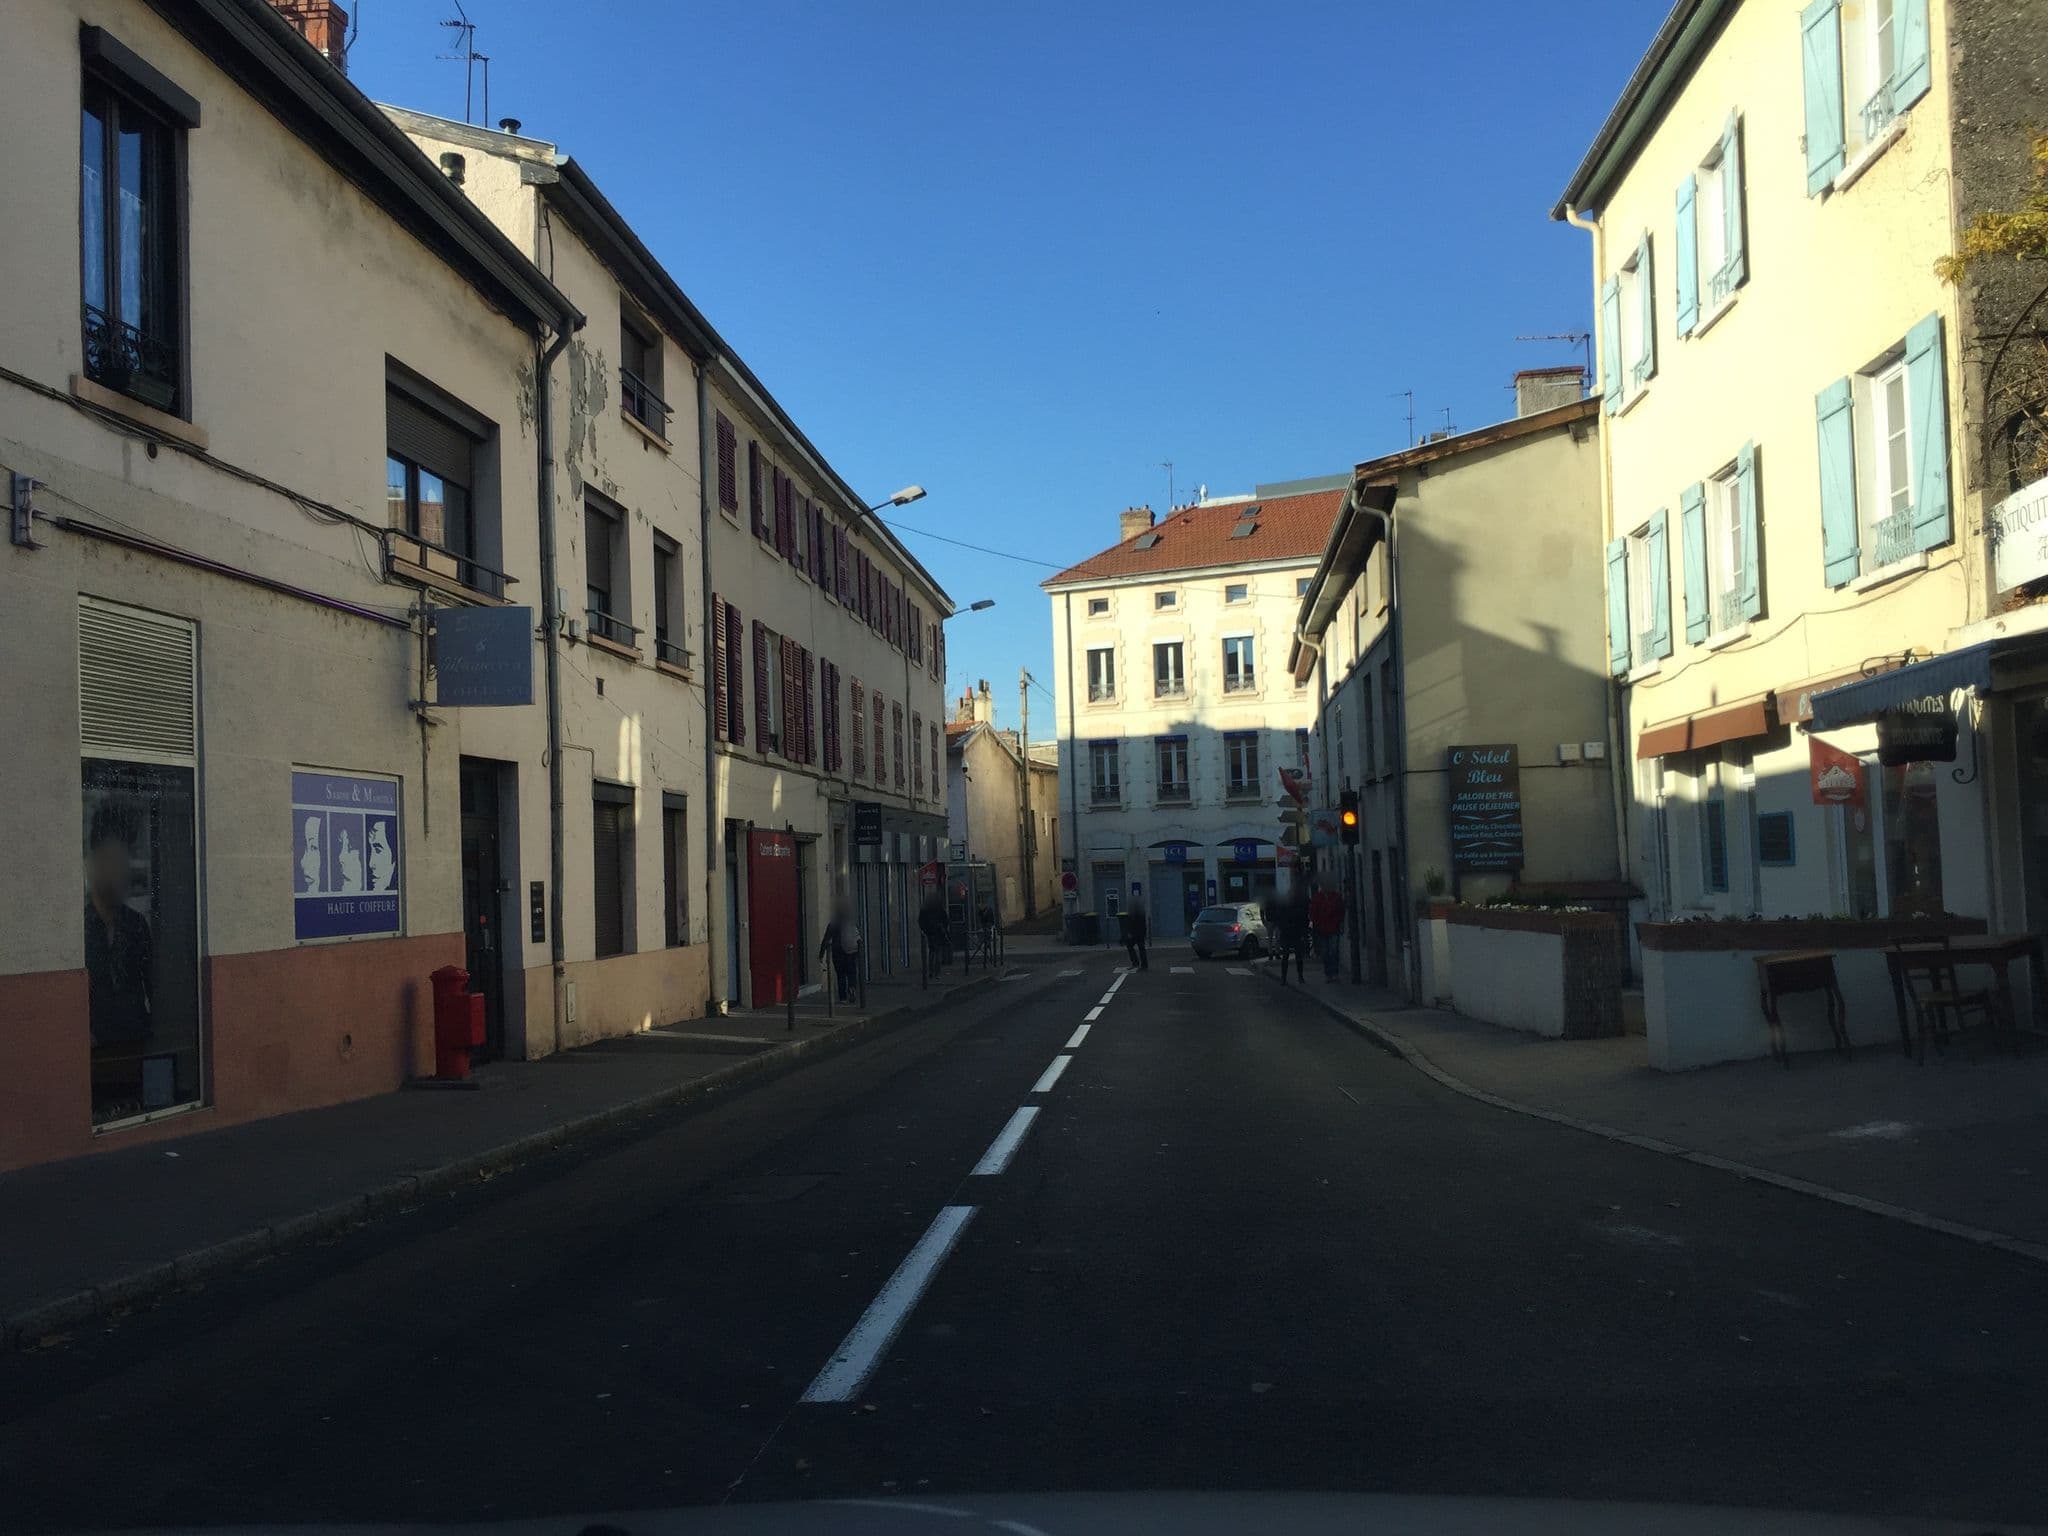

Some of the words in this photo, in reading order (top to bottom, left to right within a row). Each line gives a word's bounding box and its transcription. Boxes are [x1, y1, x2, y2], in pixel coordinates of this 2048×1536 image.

[1467, 769, 1504, 784] Bleu
[352, 783, 361, 802] &
[1457, 792, 1484, 801] SALON
[1452, 803, 1478, 811] PAUSE
[1479, 801, 1520, 810] DEJEUNER
[327, 902, 355, 914] HAUTE
[359, 900, 397, 913] COIFFURE
